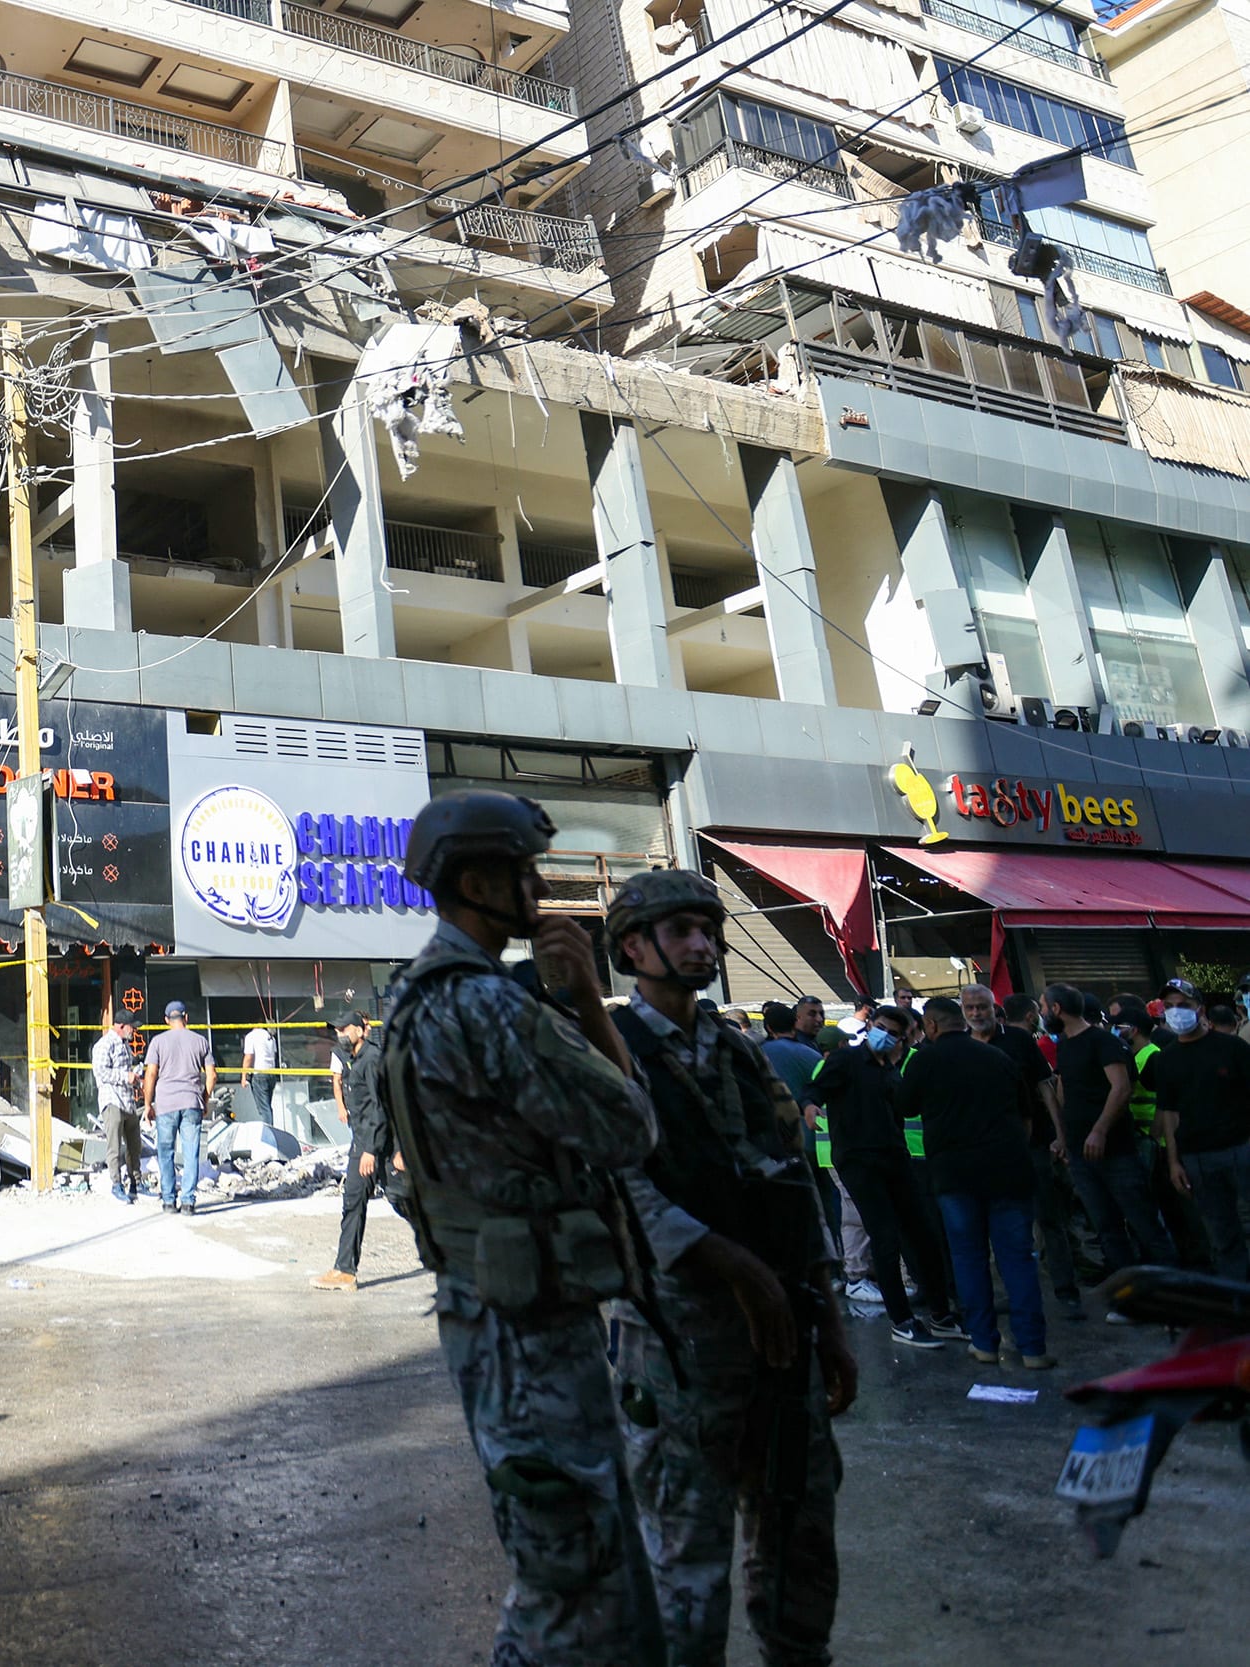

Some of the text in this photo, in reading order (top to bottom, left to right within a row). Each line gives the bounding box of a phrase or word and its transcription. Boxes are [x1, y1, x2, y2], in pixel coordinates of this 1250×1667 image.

[71, 730, 114, 747] الأصلي
[946, 774, 1139, 832] tasty bees
[297, 812, 415, 859] CHAHIN
[213, 874, 274, 891] SEA FOOD
